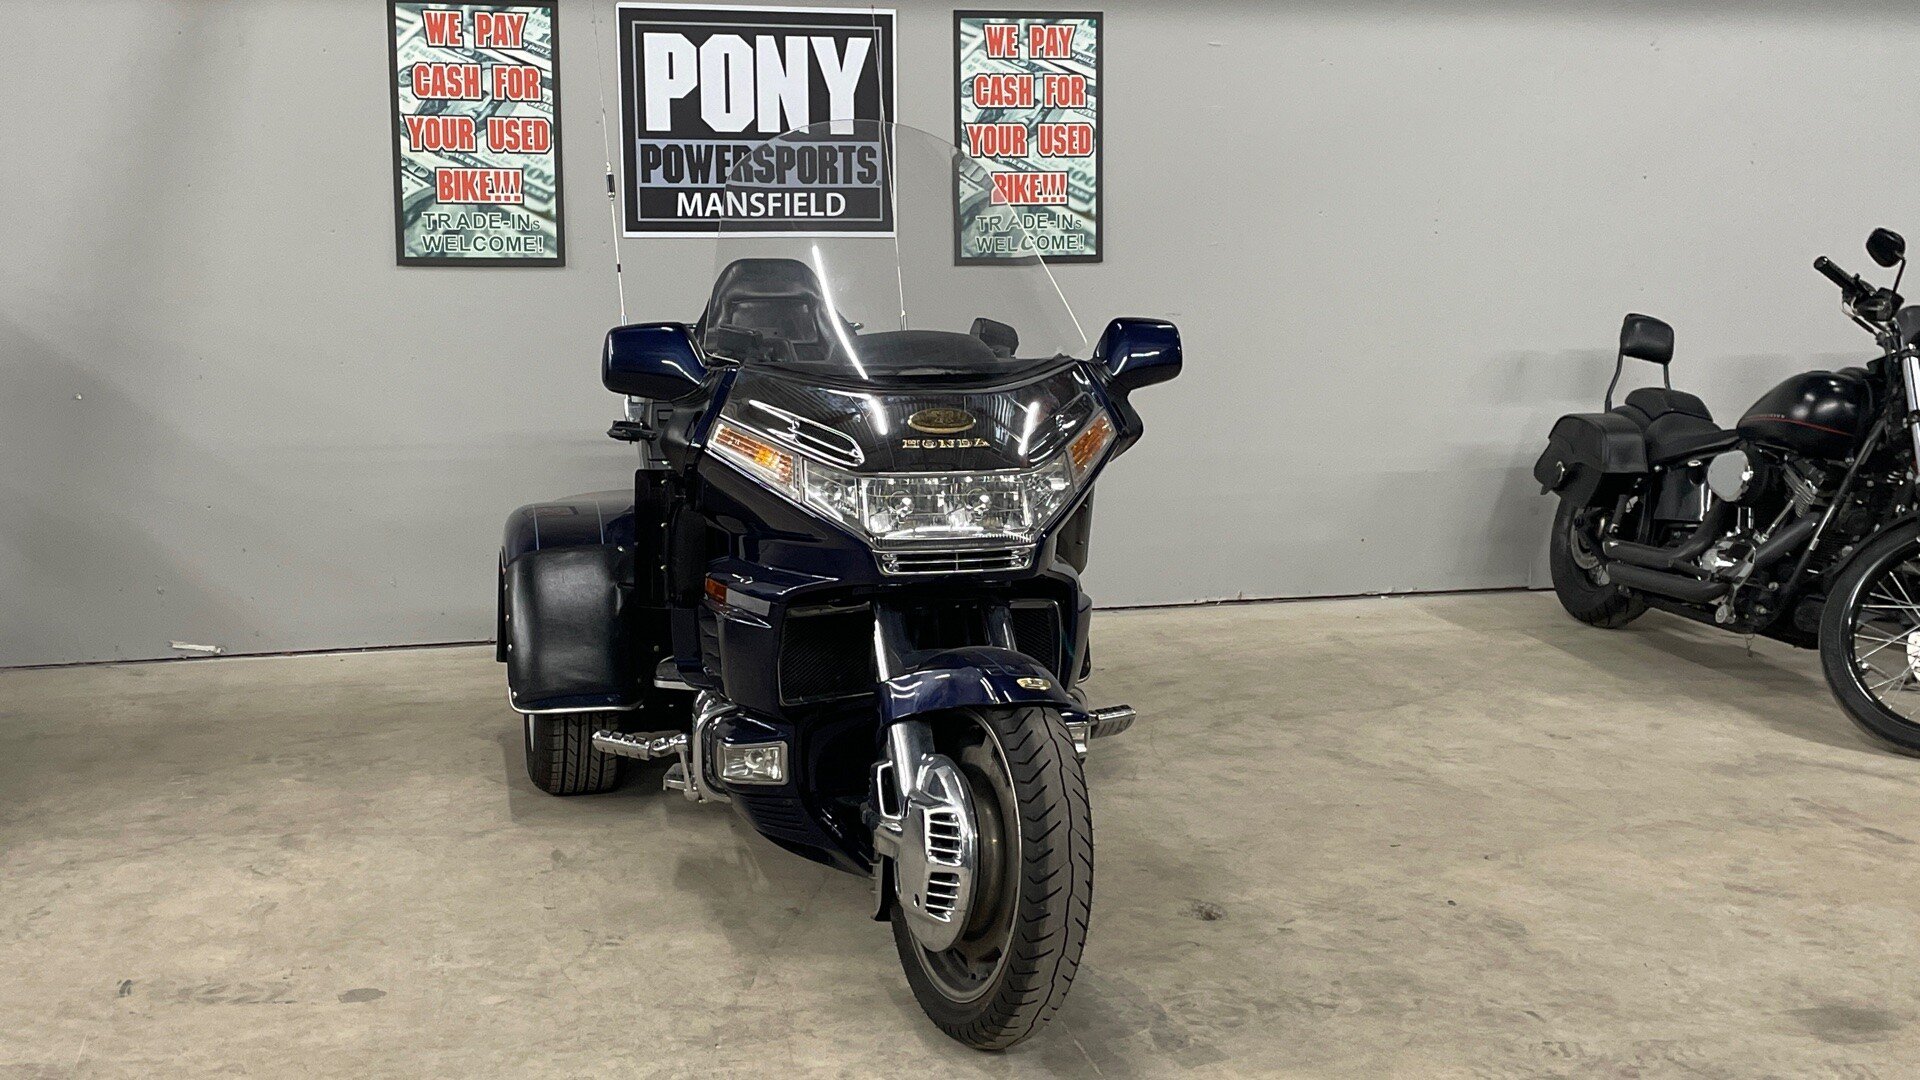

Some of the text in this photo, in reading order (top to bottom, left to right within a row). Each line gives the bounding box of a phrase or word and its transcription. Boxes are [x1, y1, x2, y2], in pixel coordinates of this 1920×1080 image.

[424, 11, 462, 47] WE
[475, 13, 526, 48] PAY
[985, 25, 1018, 58] WE
[1029, 25, 1074, 58] PAY
[413, 63, 542, 101] CASH FOR
[643, 32, 872, 135] PONY
[974, 75, 1086, 108] CASH FOR
[405, 116, 550, 153] YOUR USED
[966, 124, 1093, 157] YOUR USED
[436, 169, 523, 203] BIKE!!!
[991, 173, 1067, 205] BIKE!!!
[677, 191, 846, 217] MANSFIELD
[422, 235, 543, 252] WELCOME!
[976, 235, 1085, 252] WELCOME!
[902, 438, 990, 449] HONDA
